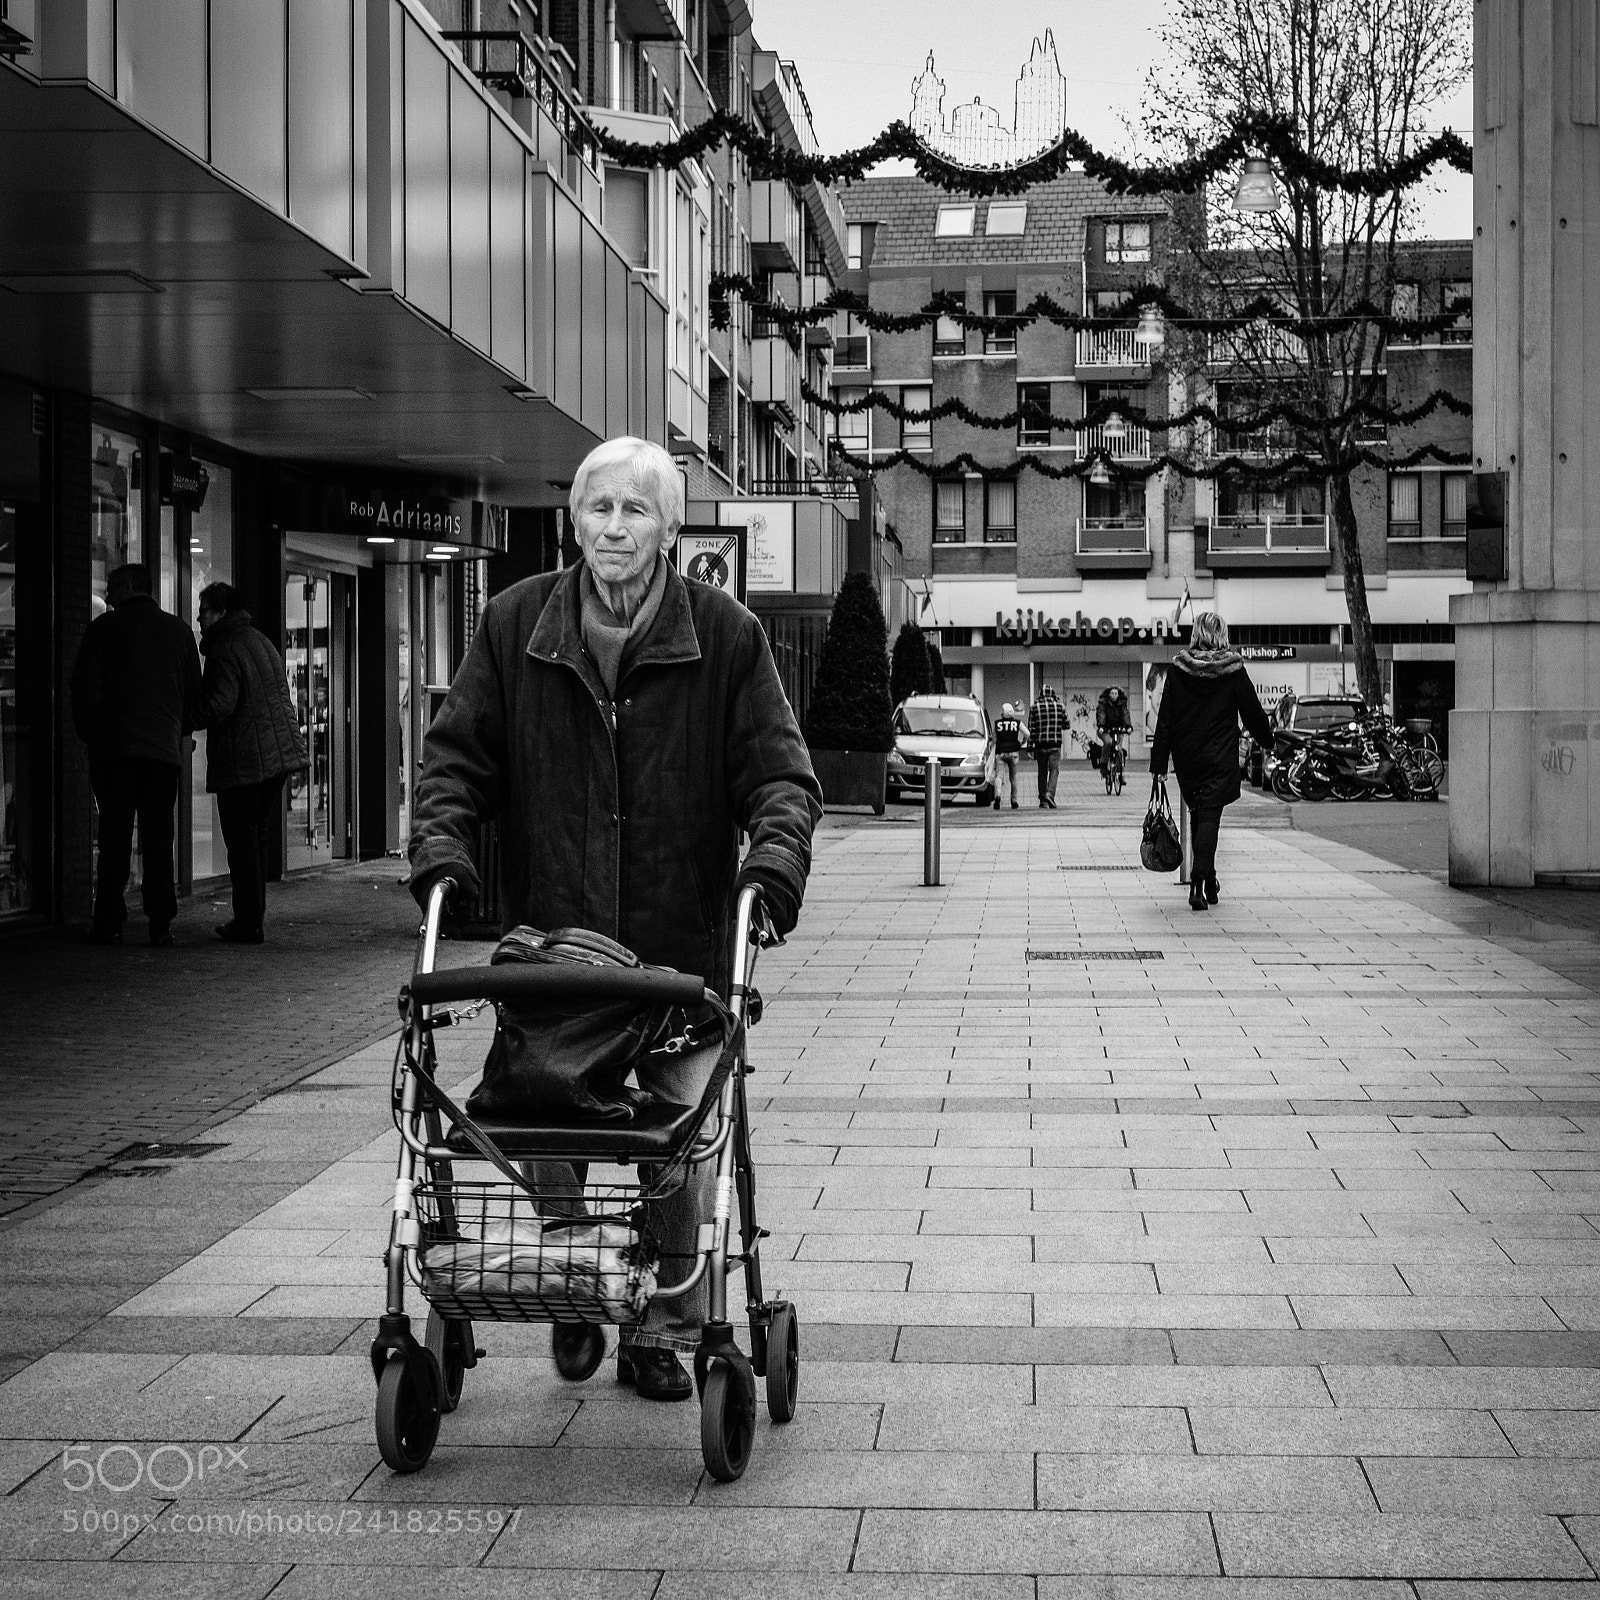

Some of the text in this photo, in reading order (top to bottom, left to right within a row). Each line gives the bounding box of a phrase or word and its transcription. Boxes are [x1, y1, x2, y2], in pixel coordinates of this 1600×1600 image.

[350, 500, 462, 535] Rob Adriaans
[695, 540, 721, 549] ZONE
[996, 608, 1181, 646] kijkshop.nl
[996, 720, 1018, 732] STR
